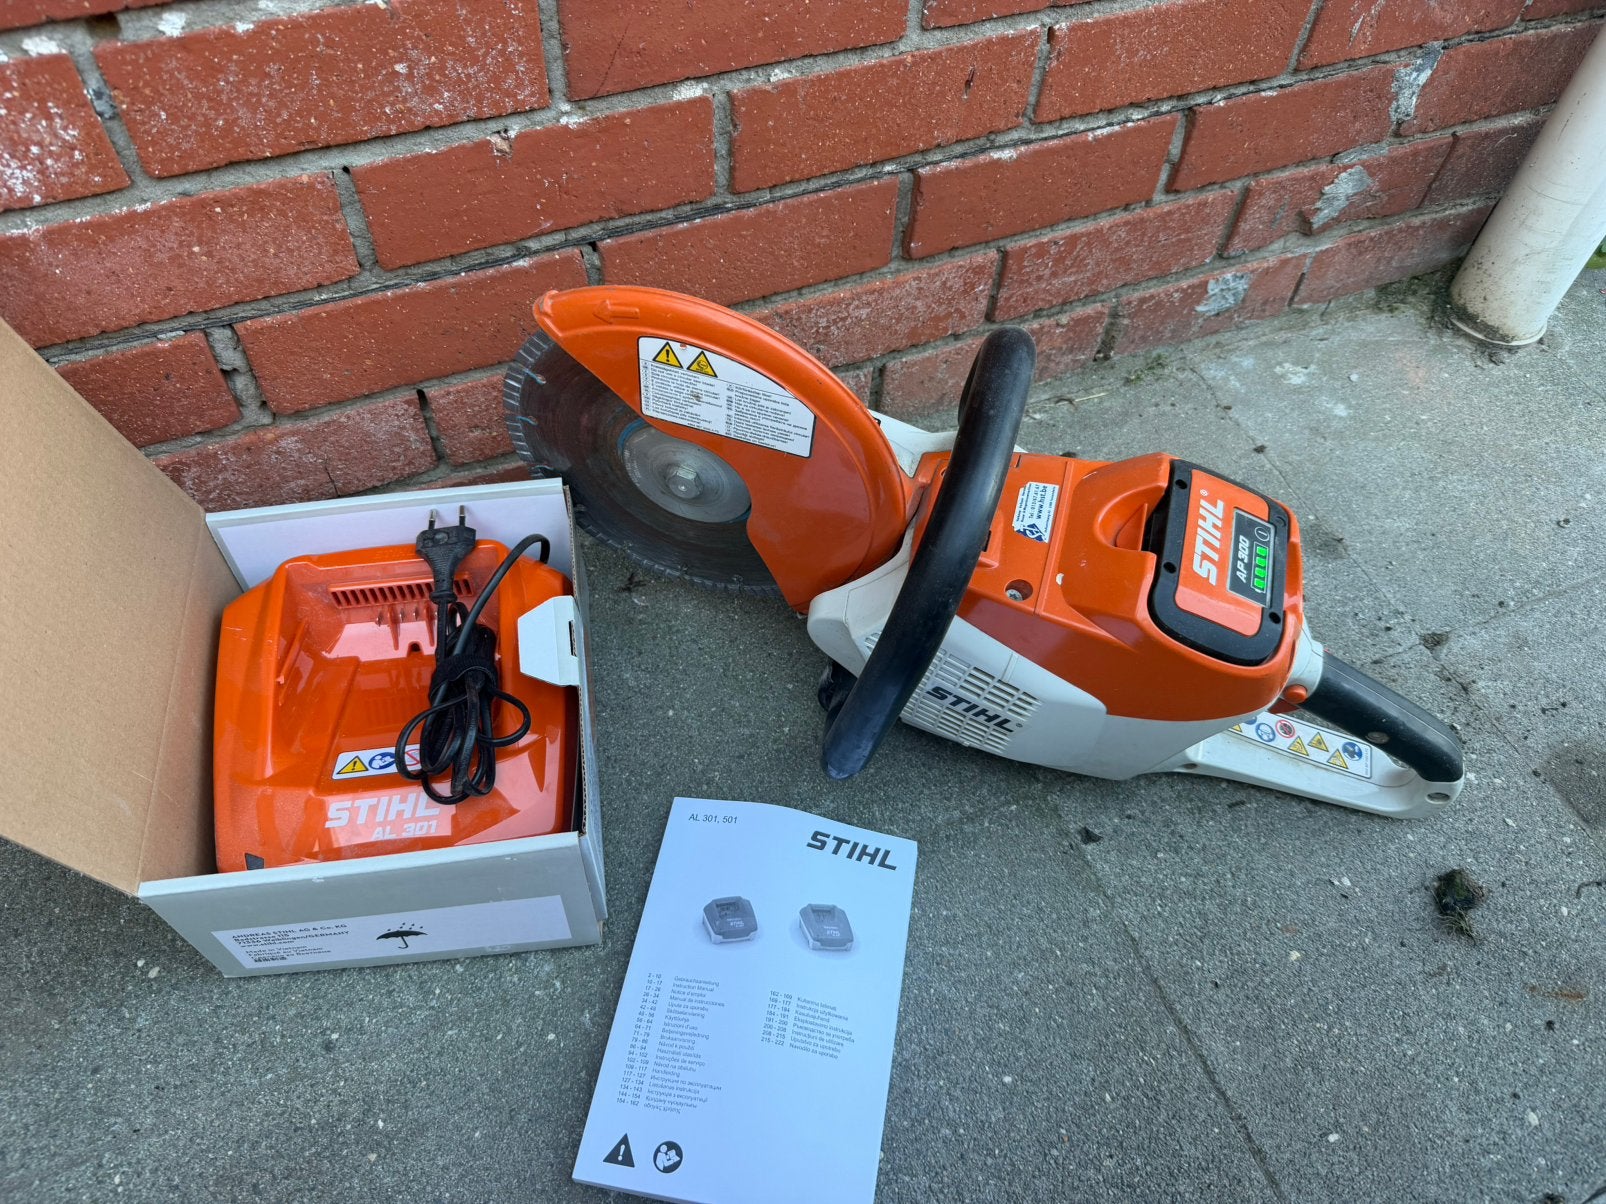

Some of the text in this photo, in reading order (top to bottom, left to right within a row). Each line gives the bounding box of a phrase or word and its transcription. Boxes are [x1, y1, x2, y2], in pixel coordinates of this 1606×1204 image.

[1193, 499, 1224, 586] STIHL
[1236, 535, 1250, 583] AP 300
[925, 686, 1014, 733] STIHL
[325, 793, 440, 828] STIHL
[371, 820, 439, 841] AL 301
[688, 813, 738, 824] AL 301, 501
[806, 830, 897, 871] STIHL
